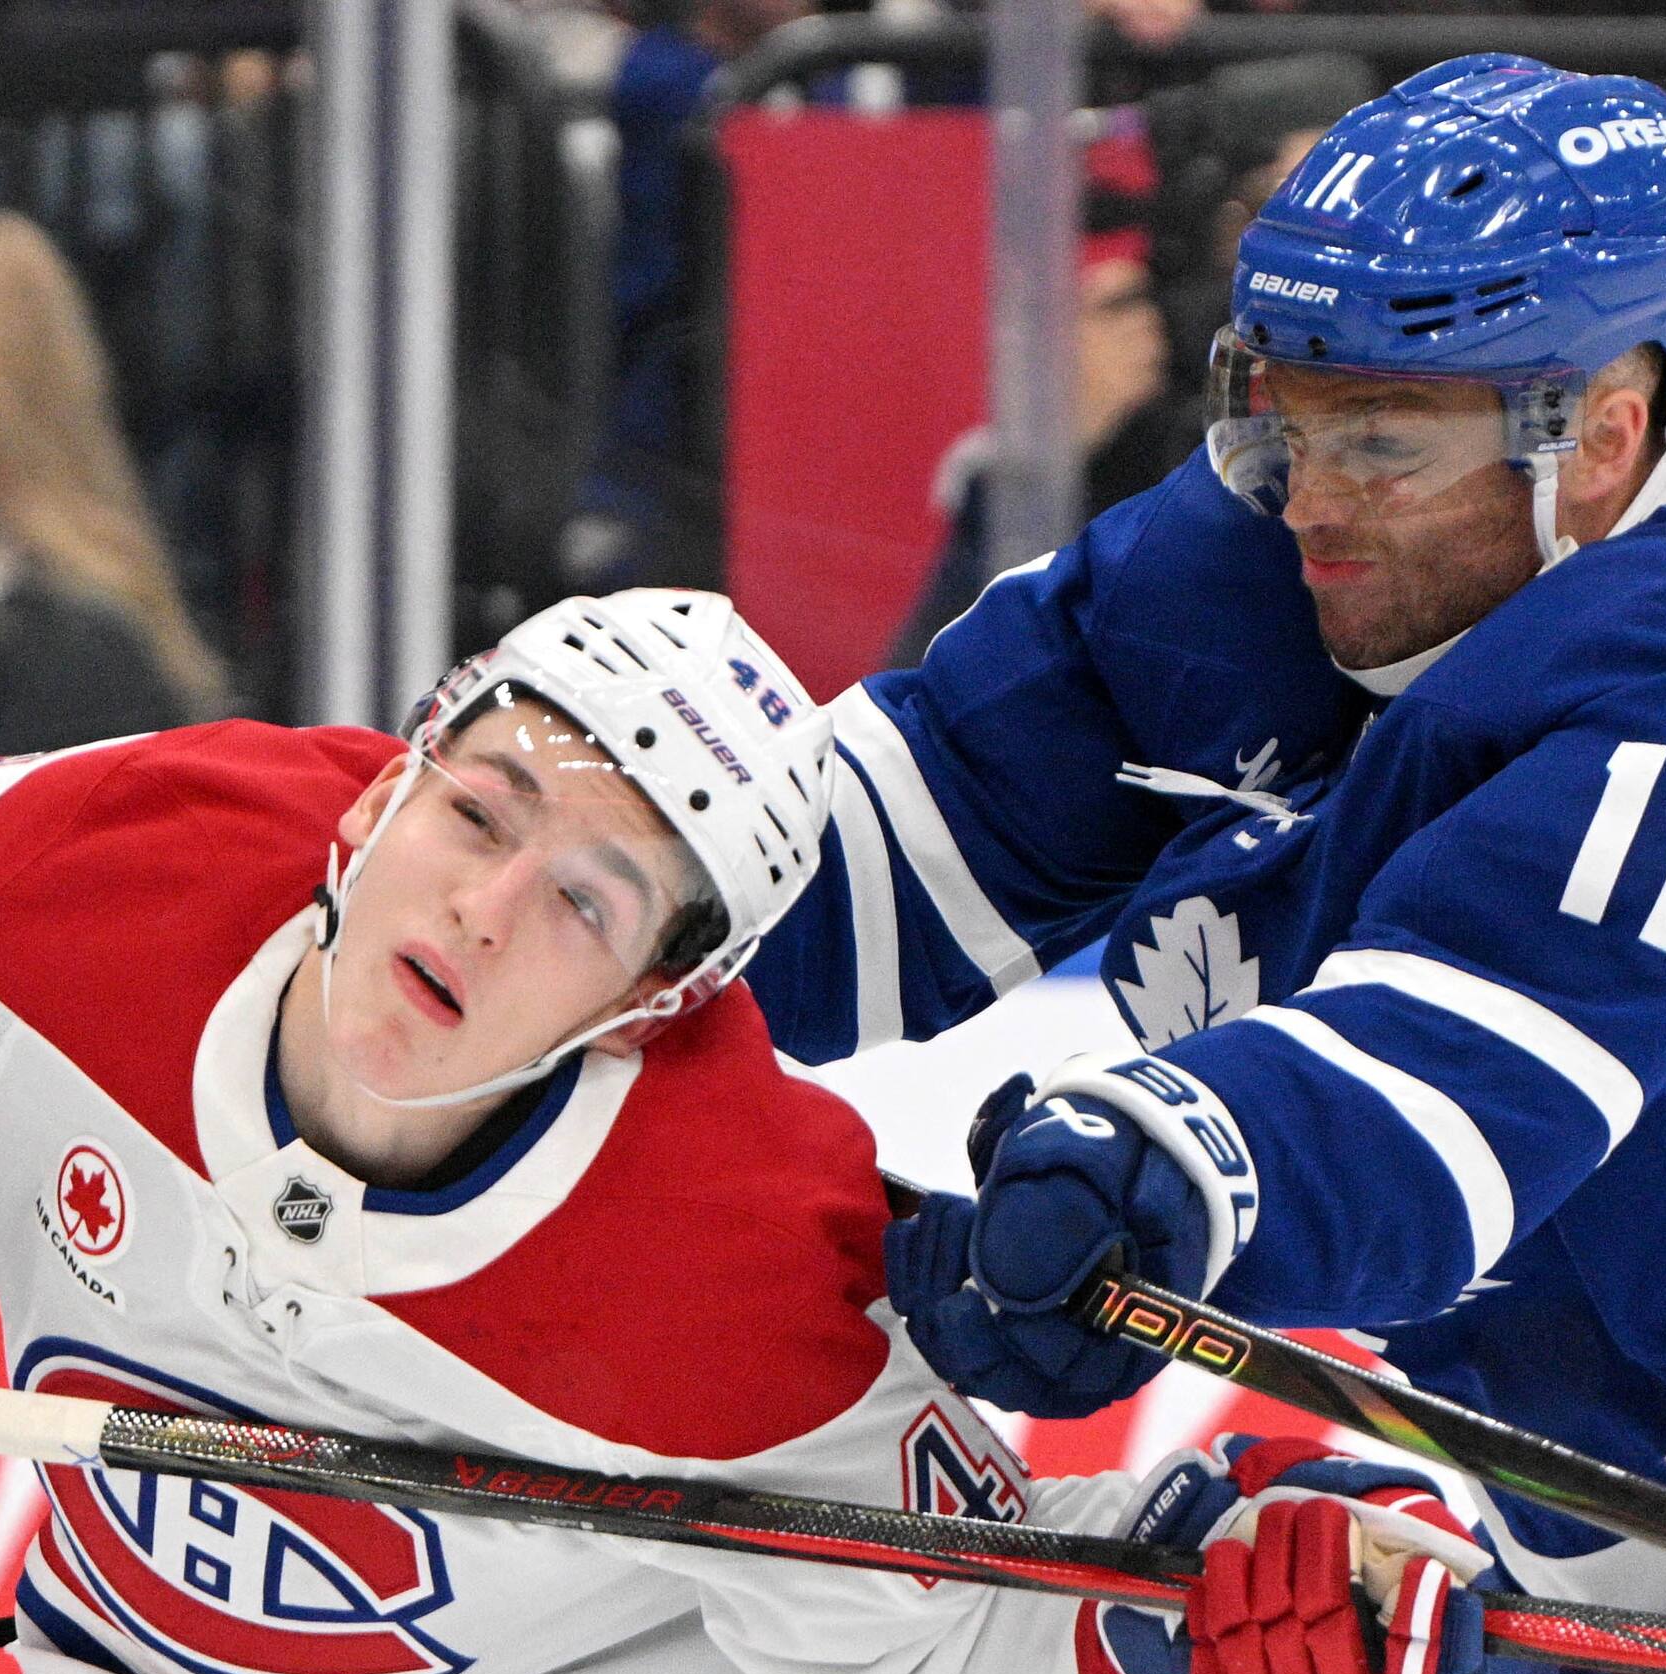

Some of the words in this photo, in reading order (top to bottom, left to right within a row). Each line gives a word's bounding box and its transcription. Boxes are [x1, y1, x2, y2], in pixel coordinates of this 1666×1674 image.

[1249, 271, 1339, 306] BAUER
[727, 658, 791, 726] 48
[661, 688, 752, 784] BAUER
[281, 1204, 321, 1220] NHL
[36, 1197, 50, 1232] AIR
[51, 1231, 116, 1304] CANADA
[487, 1470, 684, 1513] BAUER
[1133, 1471, 1191, 1543] AUER
